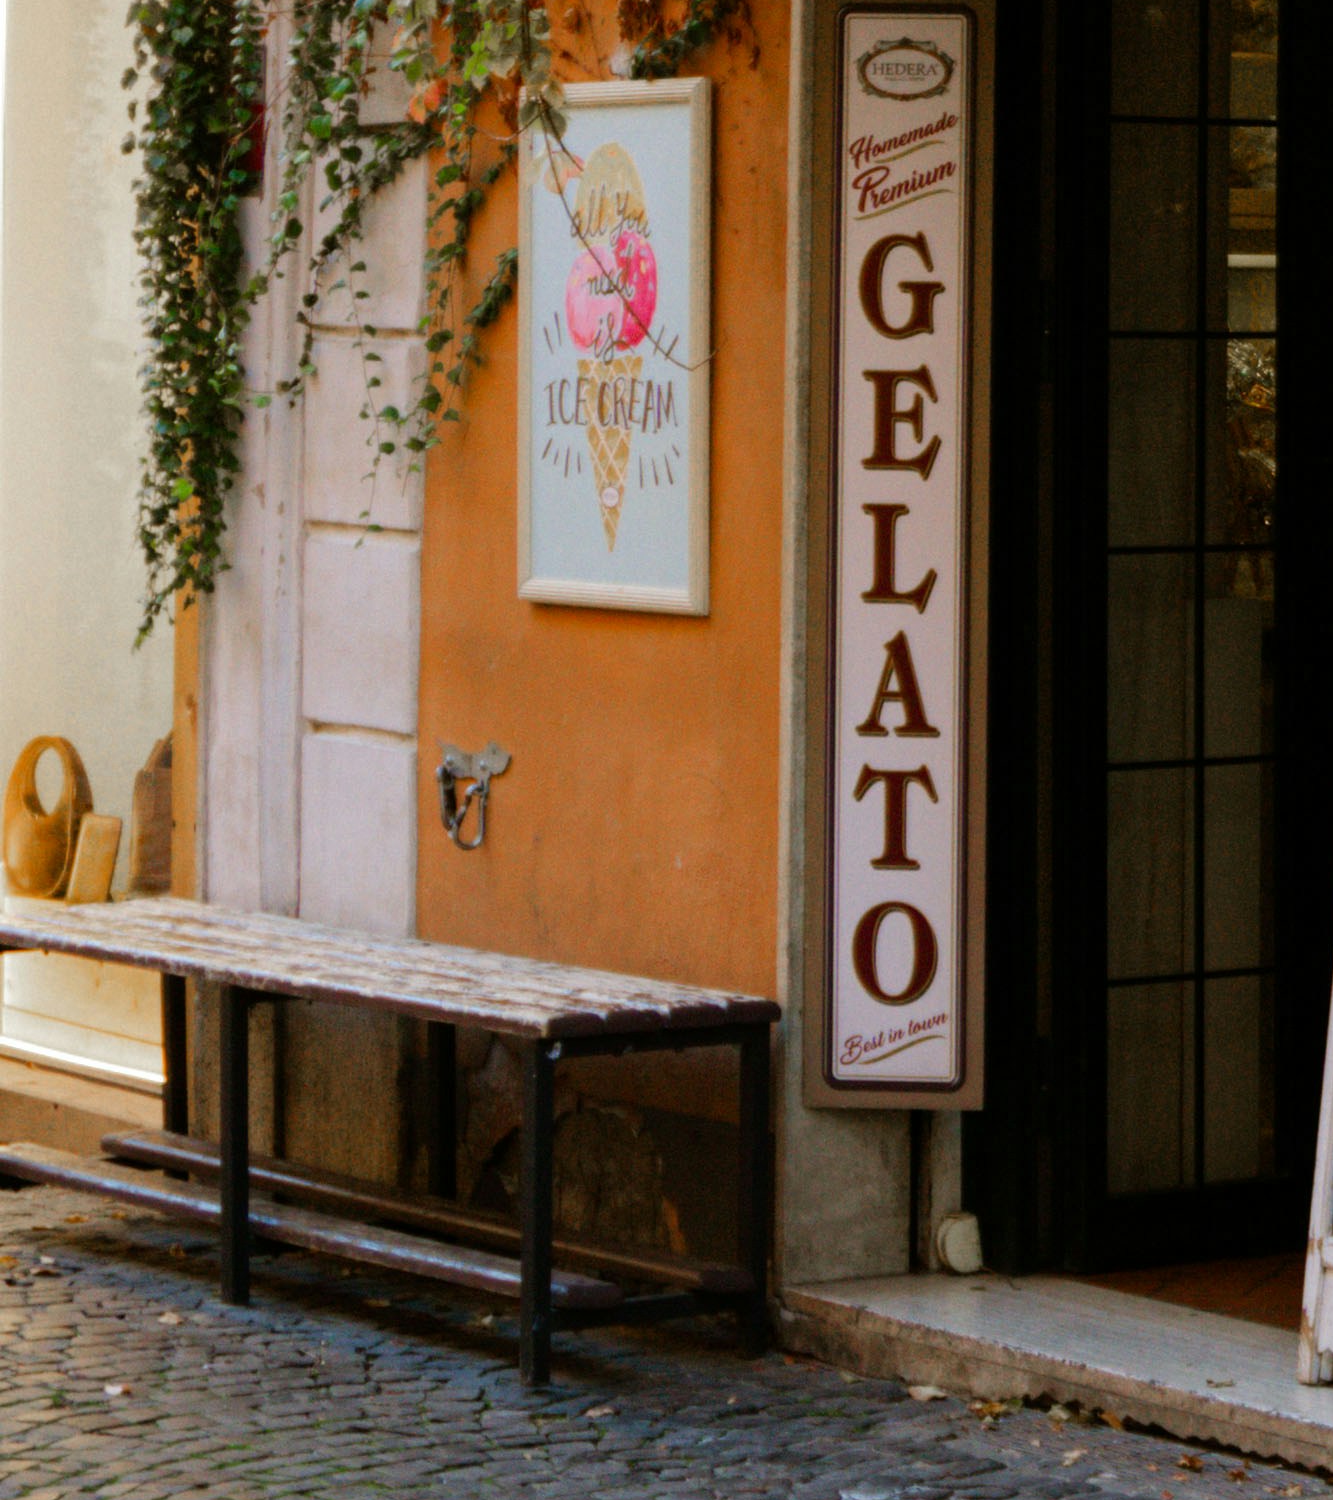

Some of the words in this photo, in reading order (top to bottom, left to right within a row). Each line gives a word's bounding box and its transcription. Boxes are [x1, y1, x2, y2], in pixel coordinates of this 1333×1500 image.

[872, 62, 937, 76] HEDERA
[849, 111, 959, 170] Homemade
[851, 160, 957, 213] Premium
[544, 378, 590, 427] ICE
[597, 376, 679, 434] CREAM
[852, 229, 946, 1007] GELATO
[840, 1031, 885, 1065] Best
[888, 1028, 905, 1043] in
[908, 1013, 948, 1035] town
